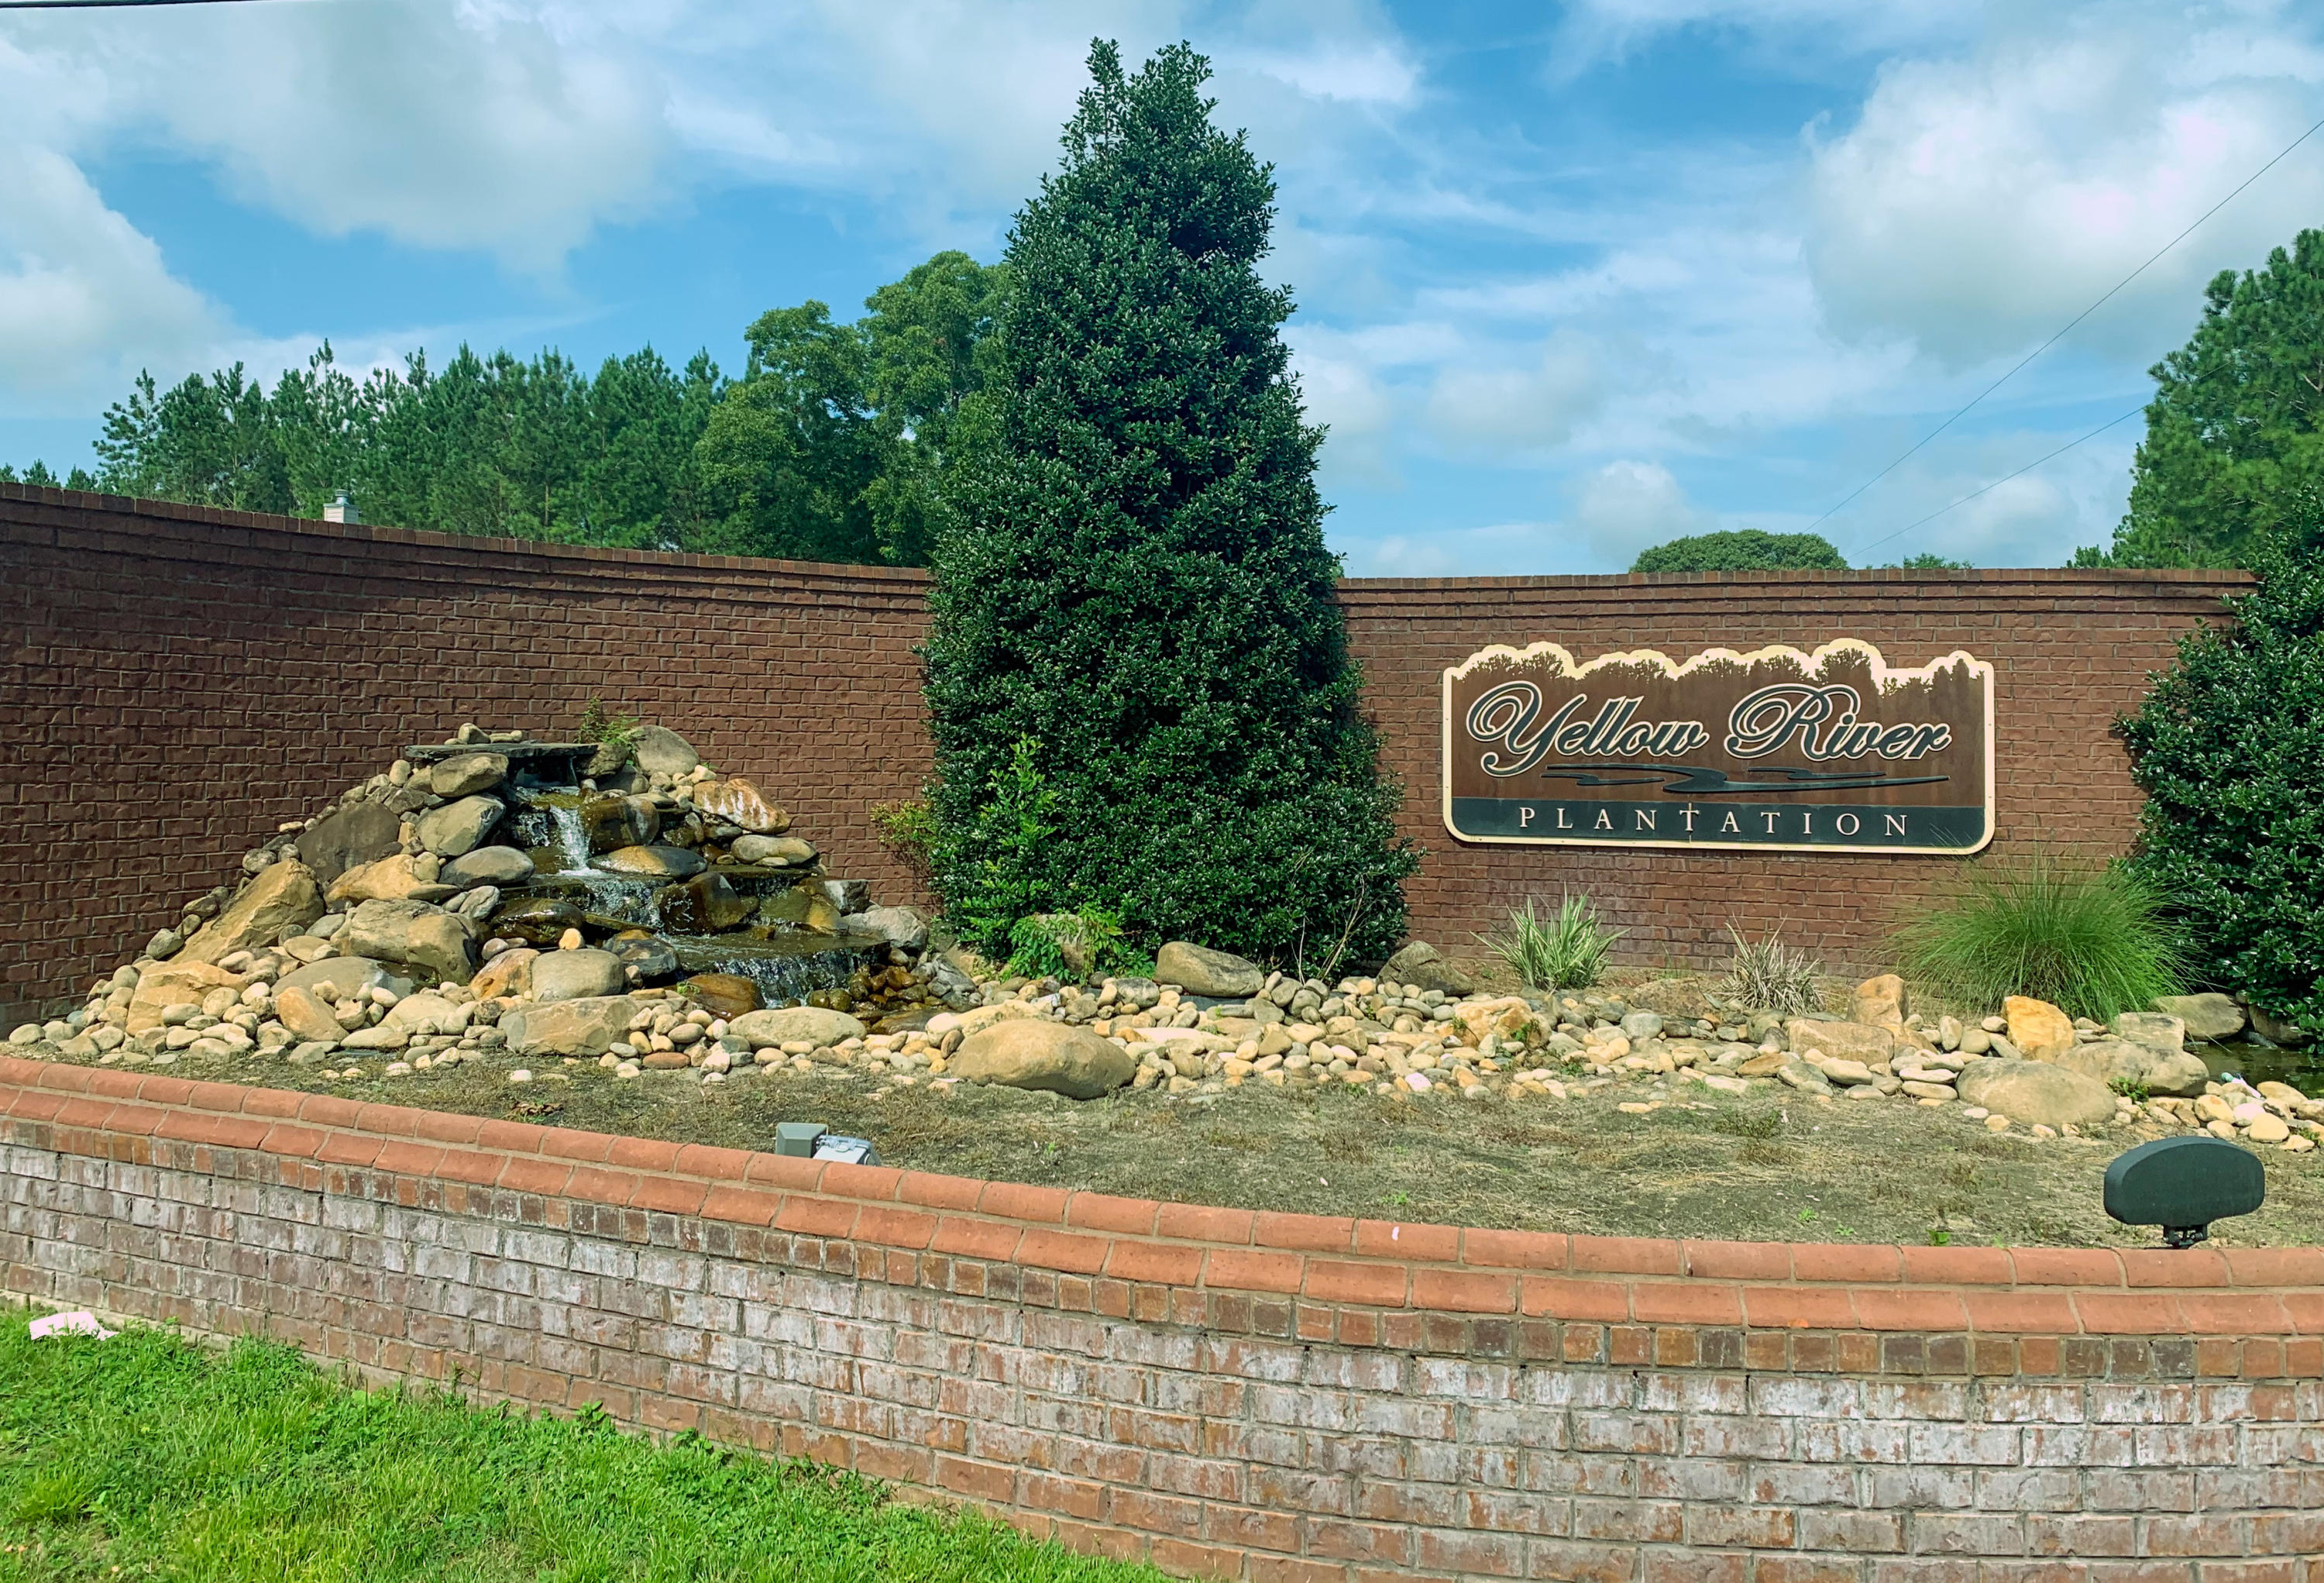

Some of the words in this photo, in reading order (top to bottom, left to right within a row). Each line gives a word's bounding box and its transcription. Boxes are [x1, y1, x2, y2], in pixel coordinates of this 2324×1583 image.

[1466, 680, 1710, 777] Yellow
[1724, 683, 1952, 762] River
[1519, 807, 1908, 837] PLANTATION
